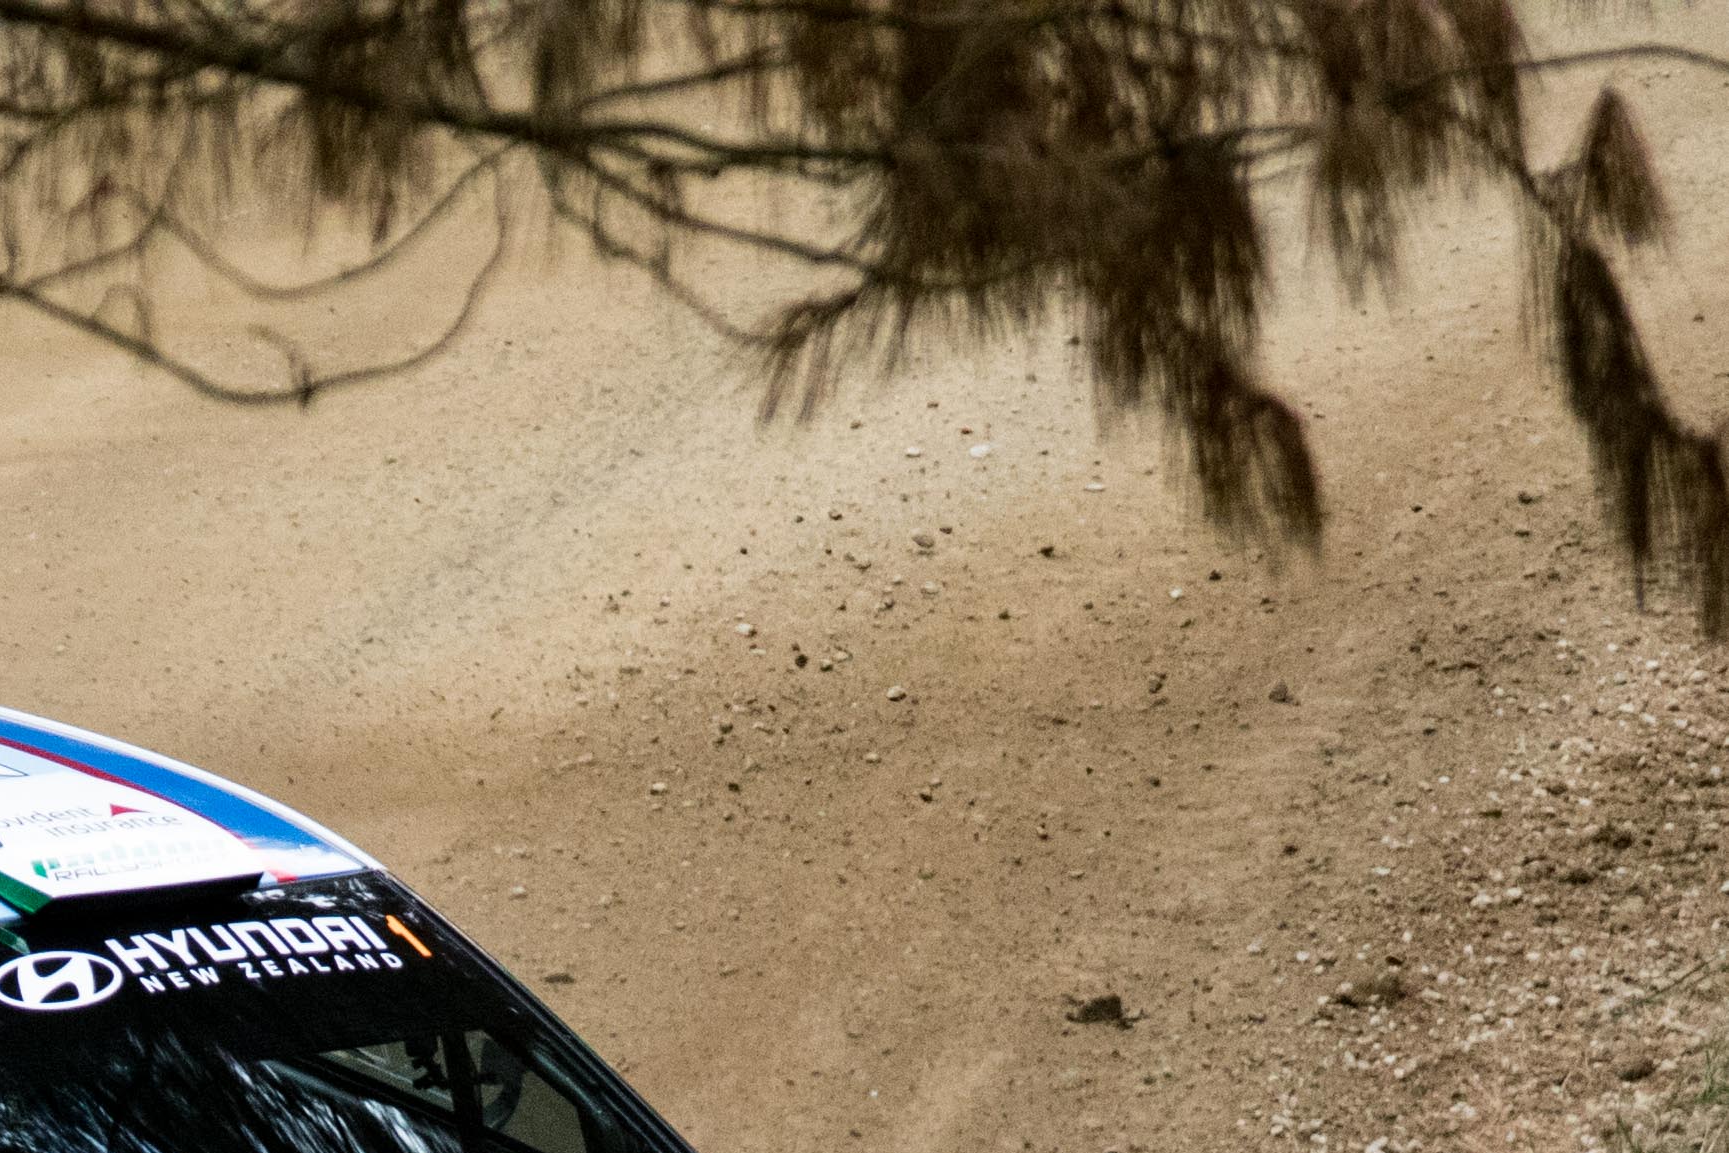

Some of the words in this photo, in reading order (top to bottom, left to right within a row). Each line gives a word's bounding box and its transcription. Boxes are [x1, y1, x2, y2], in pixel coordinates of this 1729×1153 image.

[39, 815, 182, 838] insurance
[104, 916, 387, 974] HYUNDAI
[385, 914, 432, 958] 1
[139, 965, 220, 994] NEW
[238, 952, 404, 980] ZEALAND
